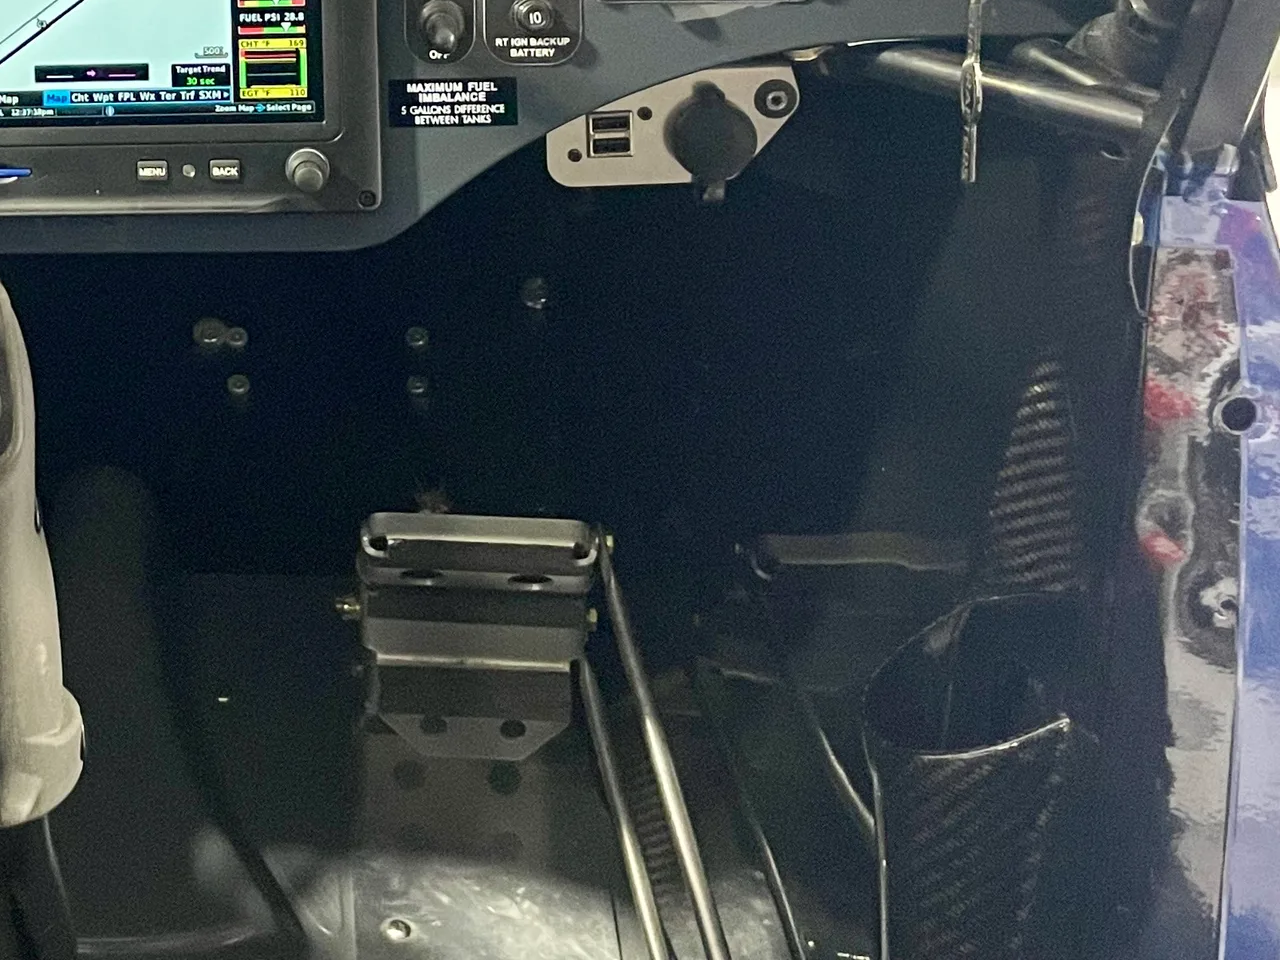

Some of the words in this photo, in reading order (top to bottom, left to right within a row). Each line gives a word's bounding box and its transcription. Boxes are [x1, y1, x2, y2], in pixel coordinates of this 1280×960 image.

[240, 13, 262, 22] FUEL
[264, 12, 280, 22] PSI
[240, 40, 258, 48] CHT
[495, 38, 508, 46] RT
[510, 38, 528, 46] IGN
[530, 37, 570, 46] BACKUP
[510, 48, 555, 58] BATTERY
[407, 82, 462, 93] MAXIMUM
[468, 82, 498, 92] FUEL
[72, 92, 90, 102] Cht
[92, 92, 114, 103] Wpt
[118, 92, 136, 102] FPL
[198, 90, 221, 100] SXM
[418, 92, 486, 102] IMBALANCE
[401, 106, 406, 115] 5
[410, 105, 452, 115] GALLONS
[454, 104, 504, 114] DIFFERENCE
[415, 115, 458, 125] BETWEEN
[462, 114, 492, 124] TANKS
[139, 166, 166, 177] MENU
[212, 166, 238, 176] BACK
